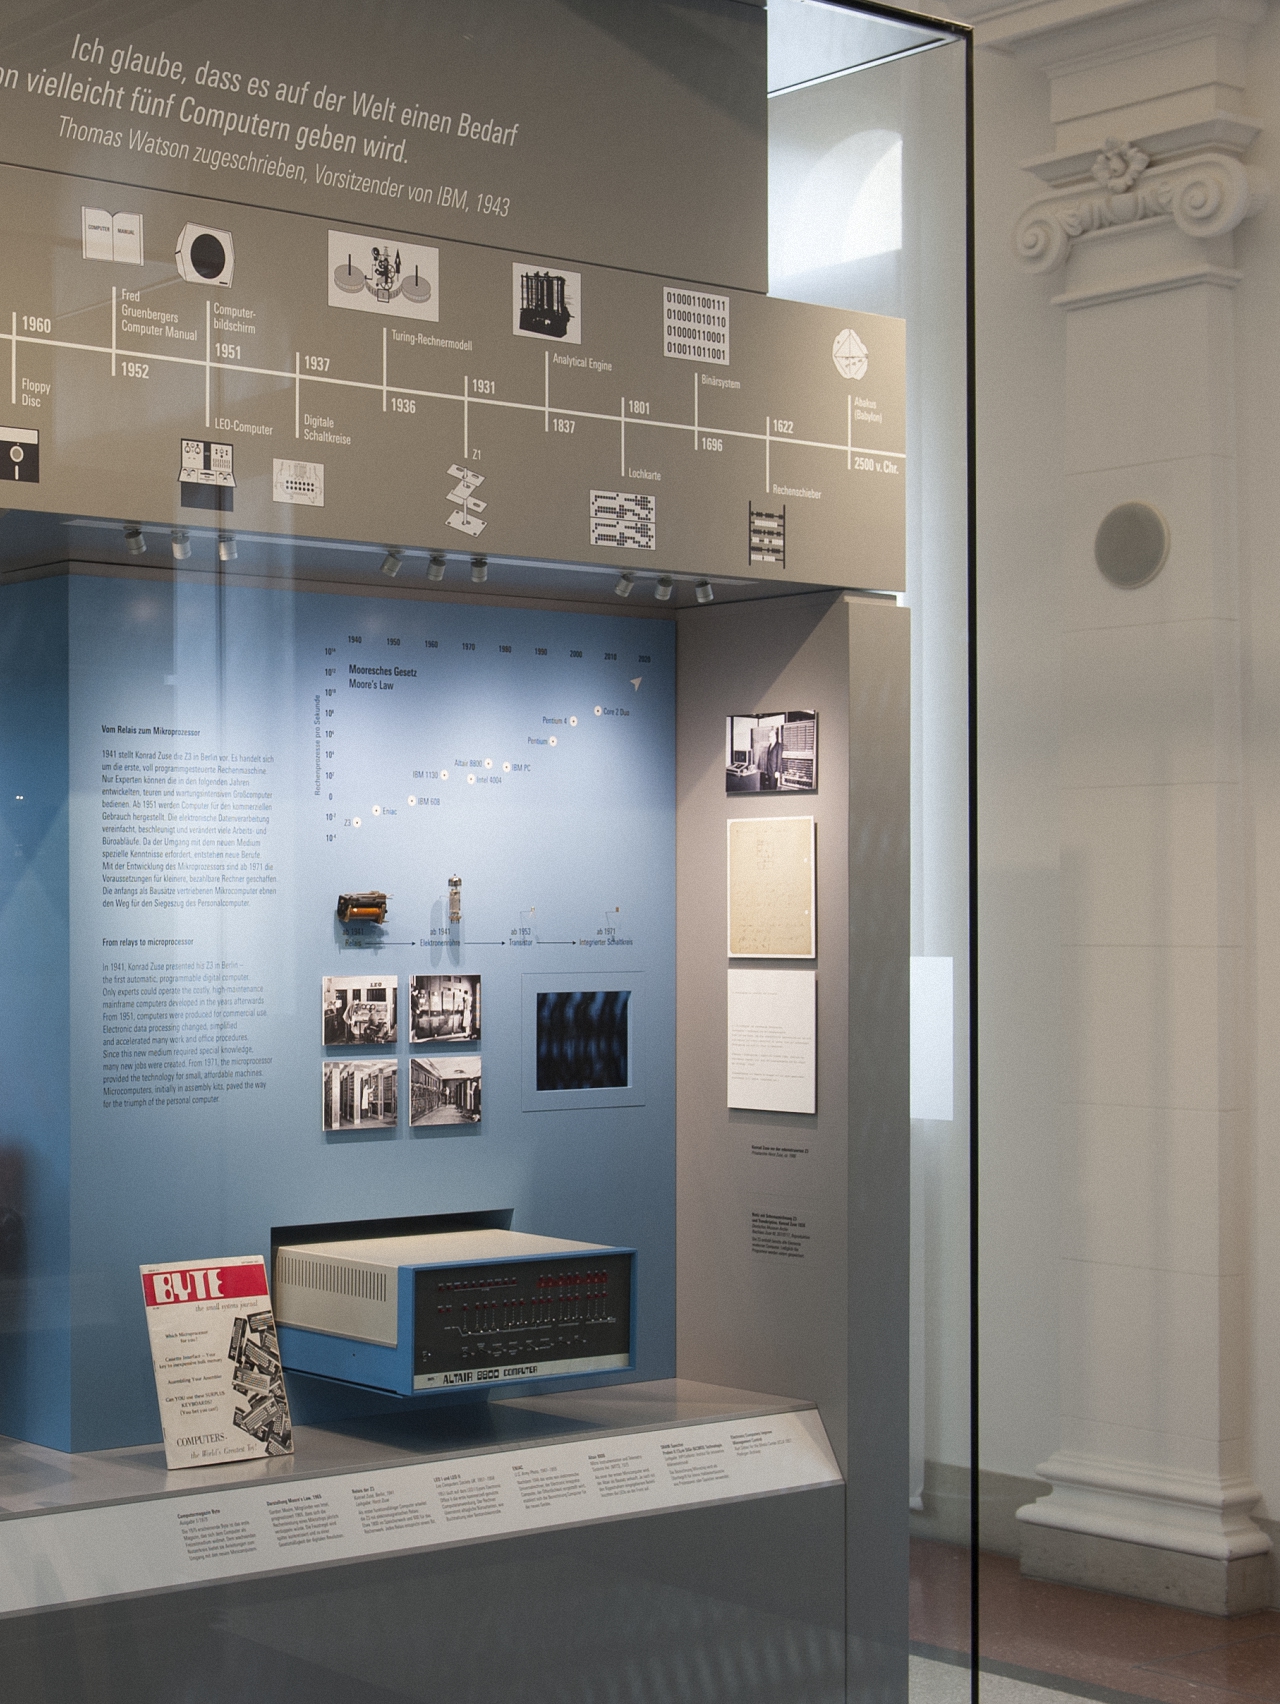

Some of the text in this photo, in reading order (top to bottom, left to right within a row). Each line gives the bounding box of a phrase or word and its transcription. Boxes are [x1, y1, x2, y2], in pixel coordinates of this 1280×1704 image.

[72, 34, 519, 146] Ich glaube, dass es auf der Welt einen Bedarf
[27, 69, 125, 108] vielleicht
[130, 86, 176, 118] fünf
[180, 96, 290, 141] Computern
[296, 124, 356, 153] geben
[364, 136, 408, 164] wird.
[59, 115, 510, 217] Thomas Watson zugeschrieben, Vorsitzender von IBM, 1943
[88, 224, 135, 236] COMPUTER MANUAL
[122, 289, 140, 302] Fred
[667, 292, 726, 312] 010001100111
[122, 304, 179, 324] Gruenbergers
[214, 302, 256, 319] Computer-
[667, 308, 726, 328] 010001010110
[22, 316, 52, 334] 1960
[122, 320, 198, 341] Computer Manual
[214, 318, 256, 334] bildschirm
[392, 330, 472, 351] Turing-Rechnermodell
[667, 325, 726, 344] 010000110001
[215, 343, 242, 360] 1951
[667, 342, 726, 360] 010011011001
[304, 356, 330, 372] 1937
[553, 353, 612, 372] Analytical Engine
[122, 362, 150, 380] 1952
[22, 378, 51, 395] Floppy
[472, 379, 495, 394] 1931
[702, 374, 740, 390] Binärsystem
[22, 394, 42, 408] Disc
[391, 398, 416, 414] 1936
[628, 400, 650, 415] 1801
[854, 397, 876, 409] Abakus
[304, 414, 334, 428] Digitale
[854, 410, 882, 424] (Babylon)
[215, 418, 274, 436] LEO-Computer
[553, 418, 575, 434] 1837
[773, 419, 794, 434] 1622
[304, 429, 351, 446] Schaltkreise
[702, 438, 723, 452] 1696
[472, 449, 481, 460] Z1
[854, 457, 899, 474] 2500 v. Chr.
[628, 468, 662, 481] Lochkarte
[773, 484, 822, 500] Rechenschieber
[348, 636, 362, 644] 1940
[387, 638, 400, 646] 1950
[425, 640, 438, 648] 1960
[535, 648, 548, 656] 1990
[570, 650, 582, 658] 2000
[349, 664, 417, 677] Mooresches Gesetz
[349, 679, 394, 690] Moore's Law
[604, 708, 614, 716] Core
[102, 725, 116, 734] Vom
[118, 726, 136, 734] Relais
[153, 727, 200, 736] Mikroprozessor
[102, 938, 118, 946] From
[120, 938, 138, 948] relays
[148, 938, 194, 947] microprocessor
[153, 1269, 224, 1304] BYTE
[442, 1366, 538, 1384] ALTAIR 8800 COMPUTER
